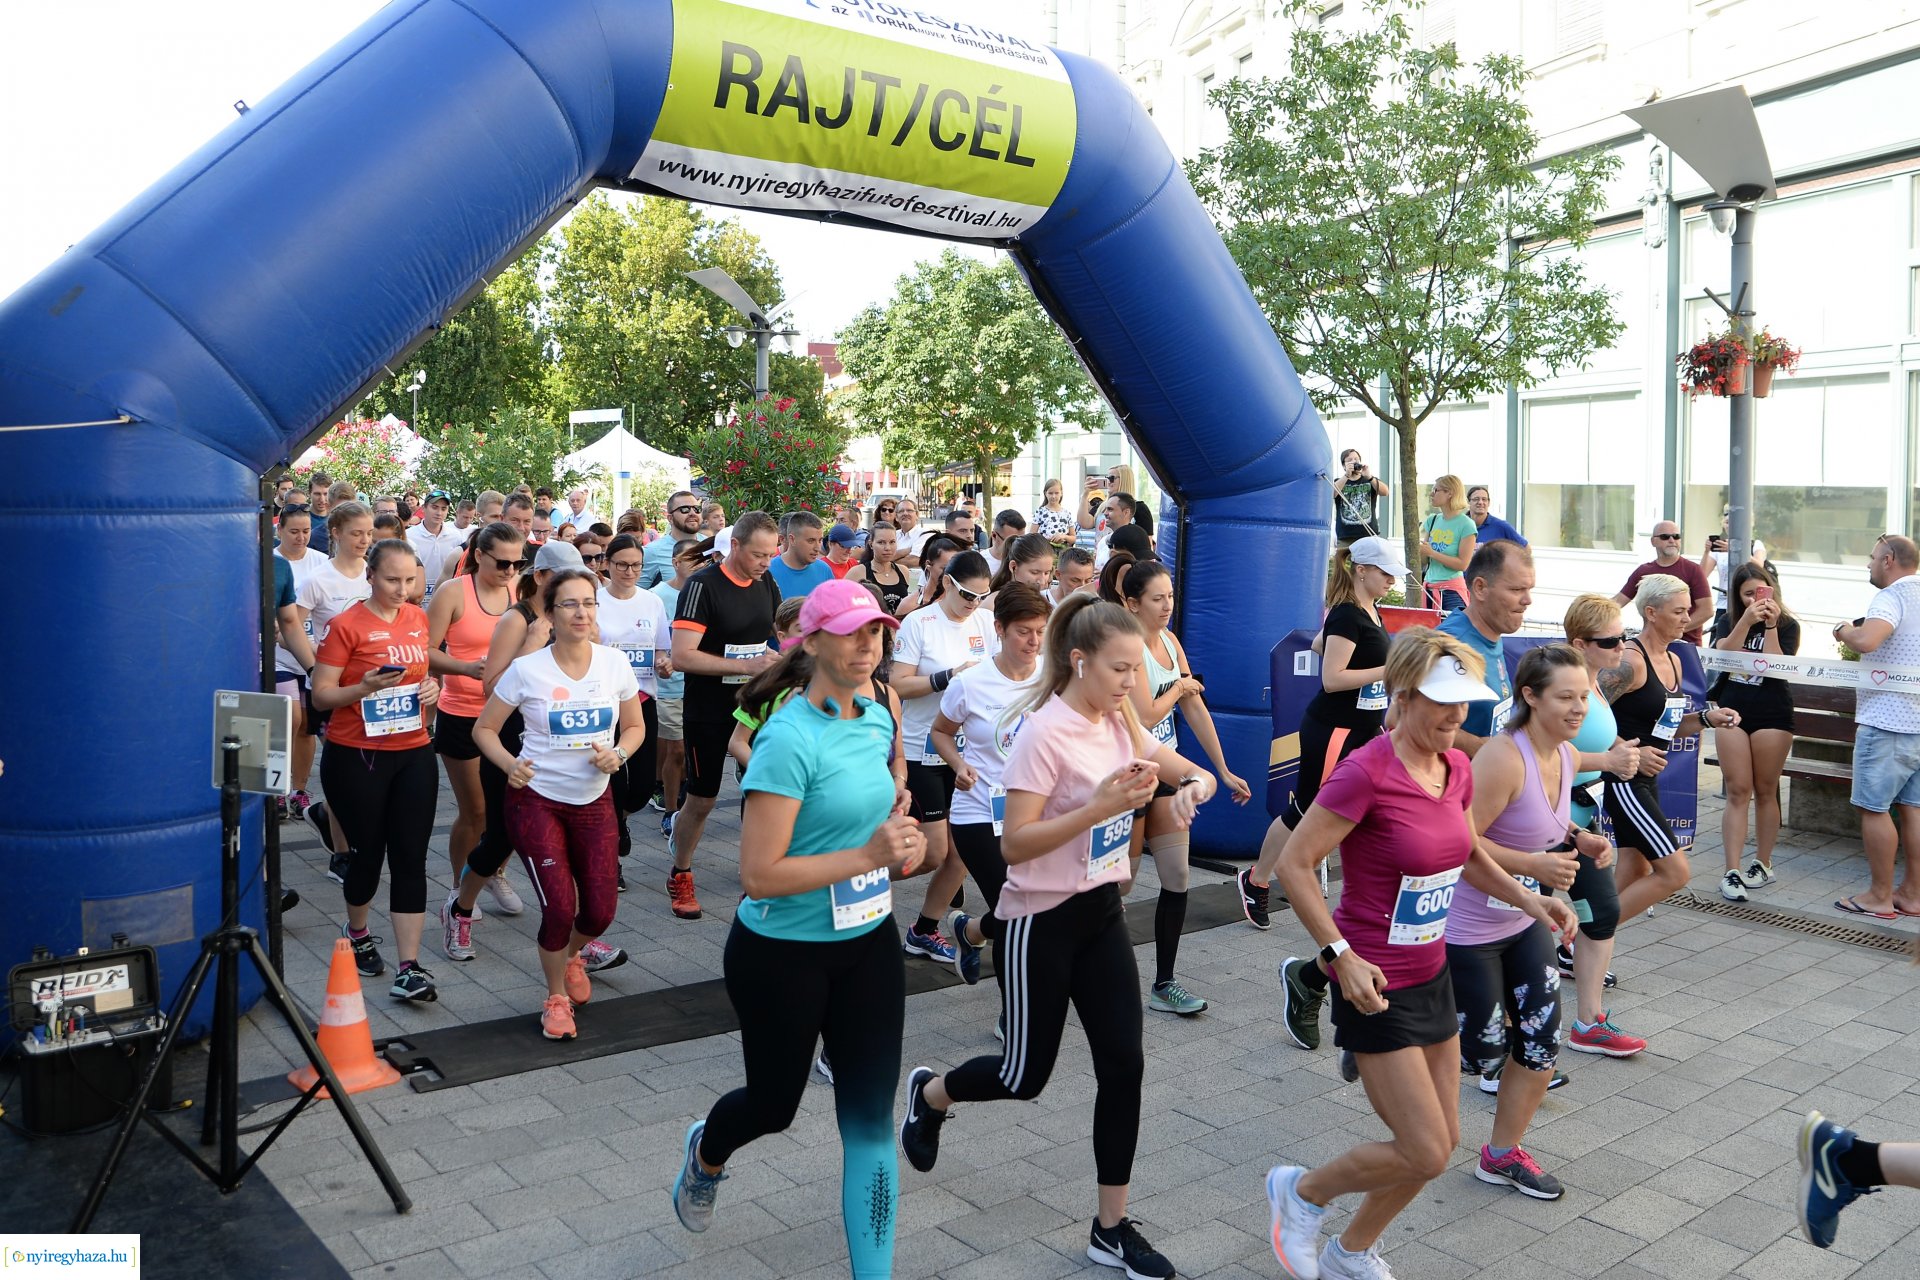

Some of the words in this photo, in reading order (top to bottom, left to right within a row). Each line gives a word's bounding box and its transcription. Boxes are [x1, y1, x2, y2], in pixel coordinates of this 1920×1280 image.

[831, 5, 849, 16] az
[951, 33, 1048, 66] támogatásával
[713, 41, 1037, 167] RAJT/CÉL
[657, 157, 1022, 230] www.nyiregyhazifutofesztival.hu
[387, 644, 425, 665] RUN
[626, 650, 645, 663] 08
[1768, 663, 1799, 672] MOZAIK
[375, 695, 413, 716] 546
[561, 709, 600, 729] 631
[272, 770, 281, 787] 7
[1103, 814, 1134, 847] 599
[1415, 885, 1455, 916] 600
